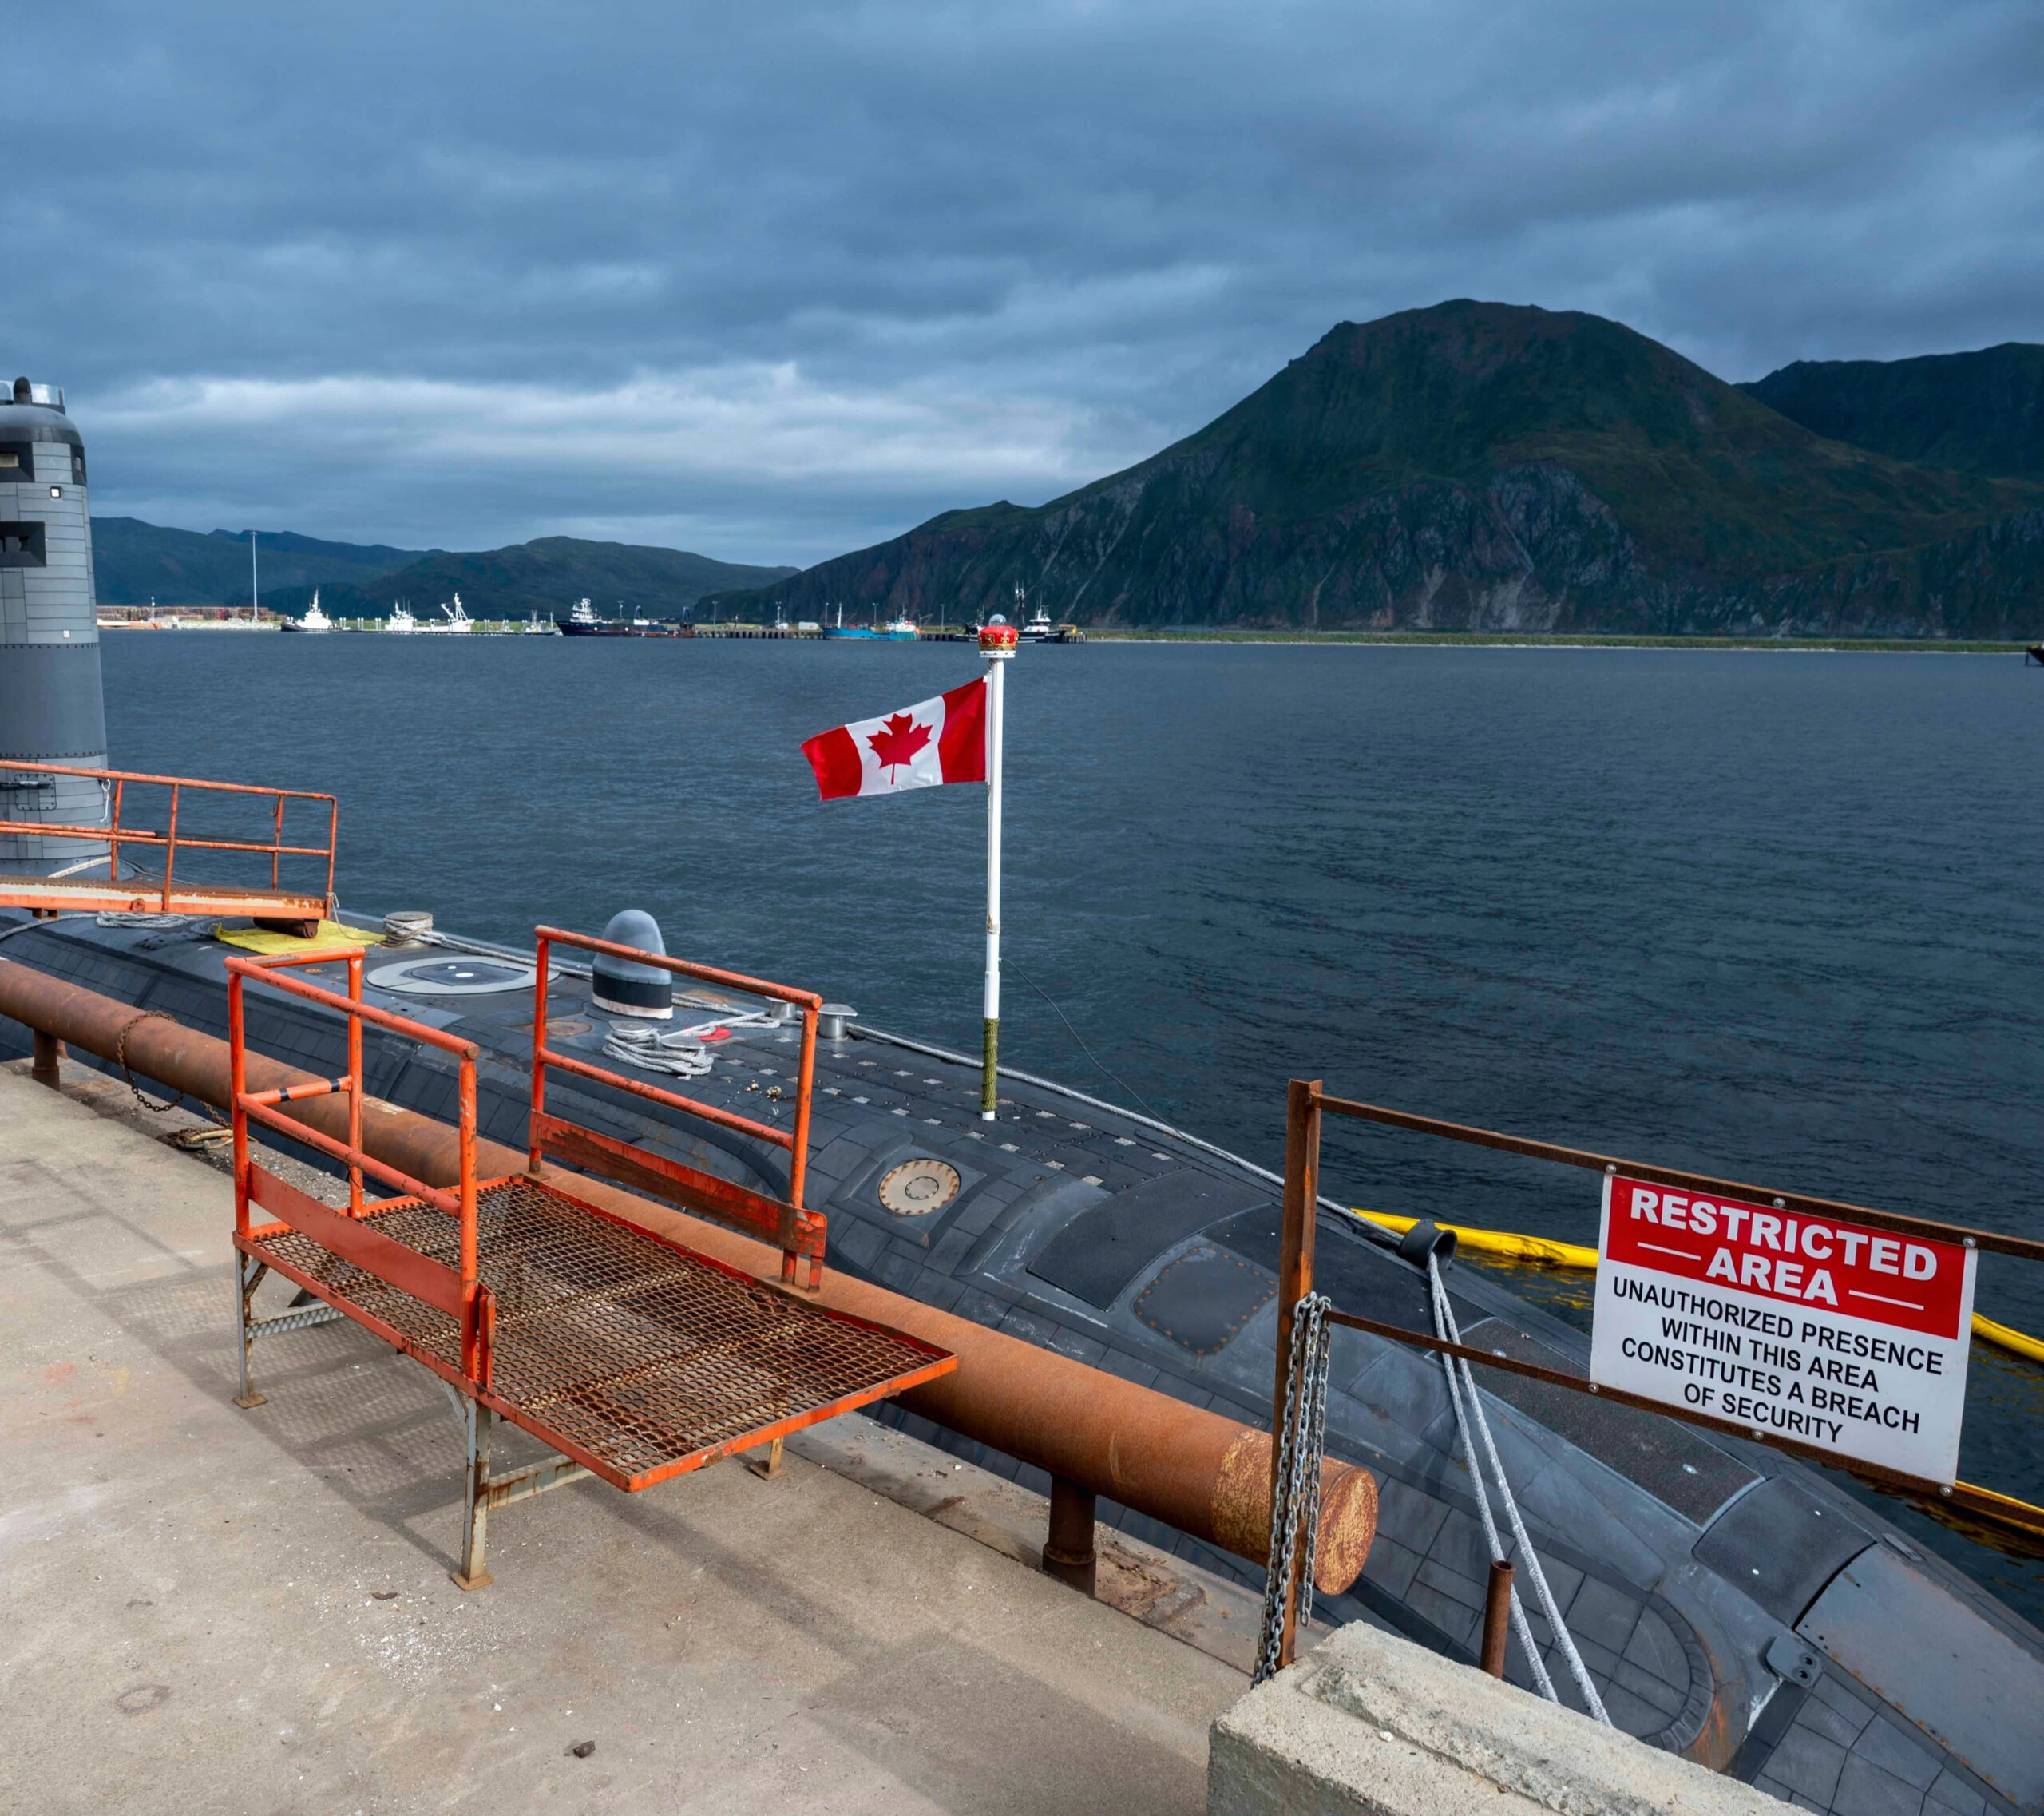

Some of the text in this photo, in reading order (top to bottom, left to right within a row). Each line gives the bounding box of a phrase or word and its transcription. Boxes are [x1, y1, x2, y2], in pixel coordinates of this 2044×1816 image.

[1630, 1188, 1937, 1281] RESTRICTED
[1705, 1247, 1838, 1306] AREA
[1614, 1276, 1943, 1375] UNAUTHORIZED PRESENCE
[1662, 1316, 1879, 1393] WITHIN THIS AREA
[1622, 1337, 1919, 1434] CONSTITUTES A BREACH
[1684, 1382, 1844, 1443] OF SECURITY
